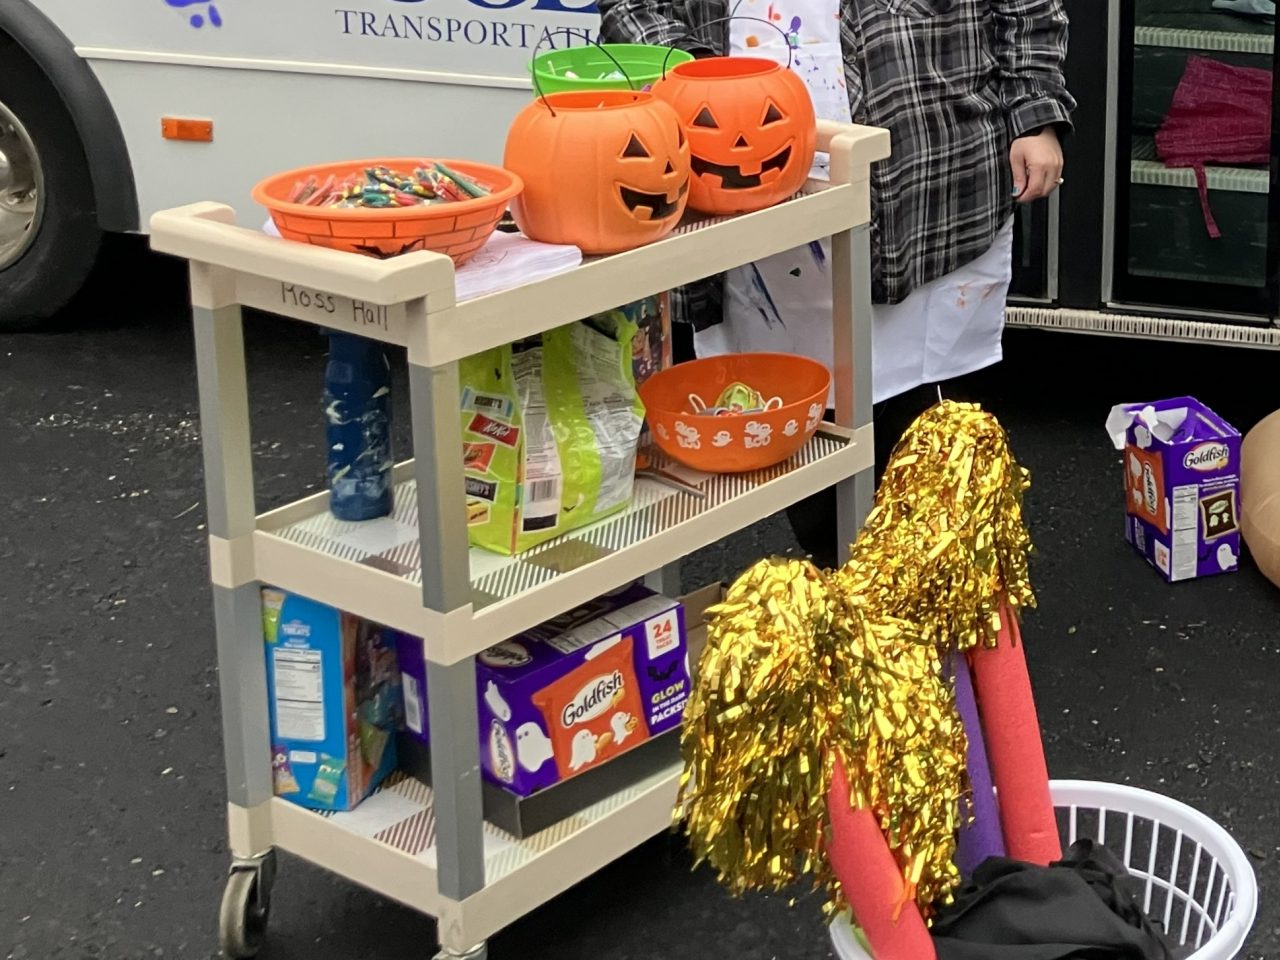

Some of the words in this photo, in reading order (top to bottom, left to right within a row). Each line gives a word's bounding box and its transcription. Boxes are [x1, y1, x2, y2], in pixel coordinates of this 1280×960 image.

[335, 9, 603, 50] TRANSPORTATI
[352, 299, 388, 331] Hall
[1184, 446, 1228, 467] Goldfish
[653, 619, 672, 638] 24
[563, 672, 622, 727] Goldfish
[652, 679, 685, 704] GLOW
